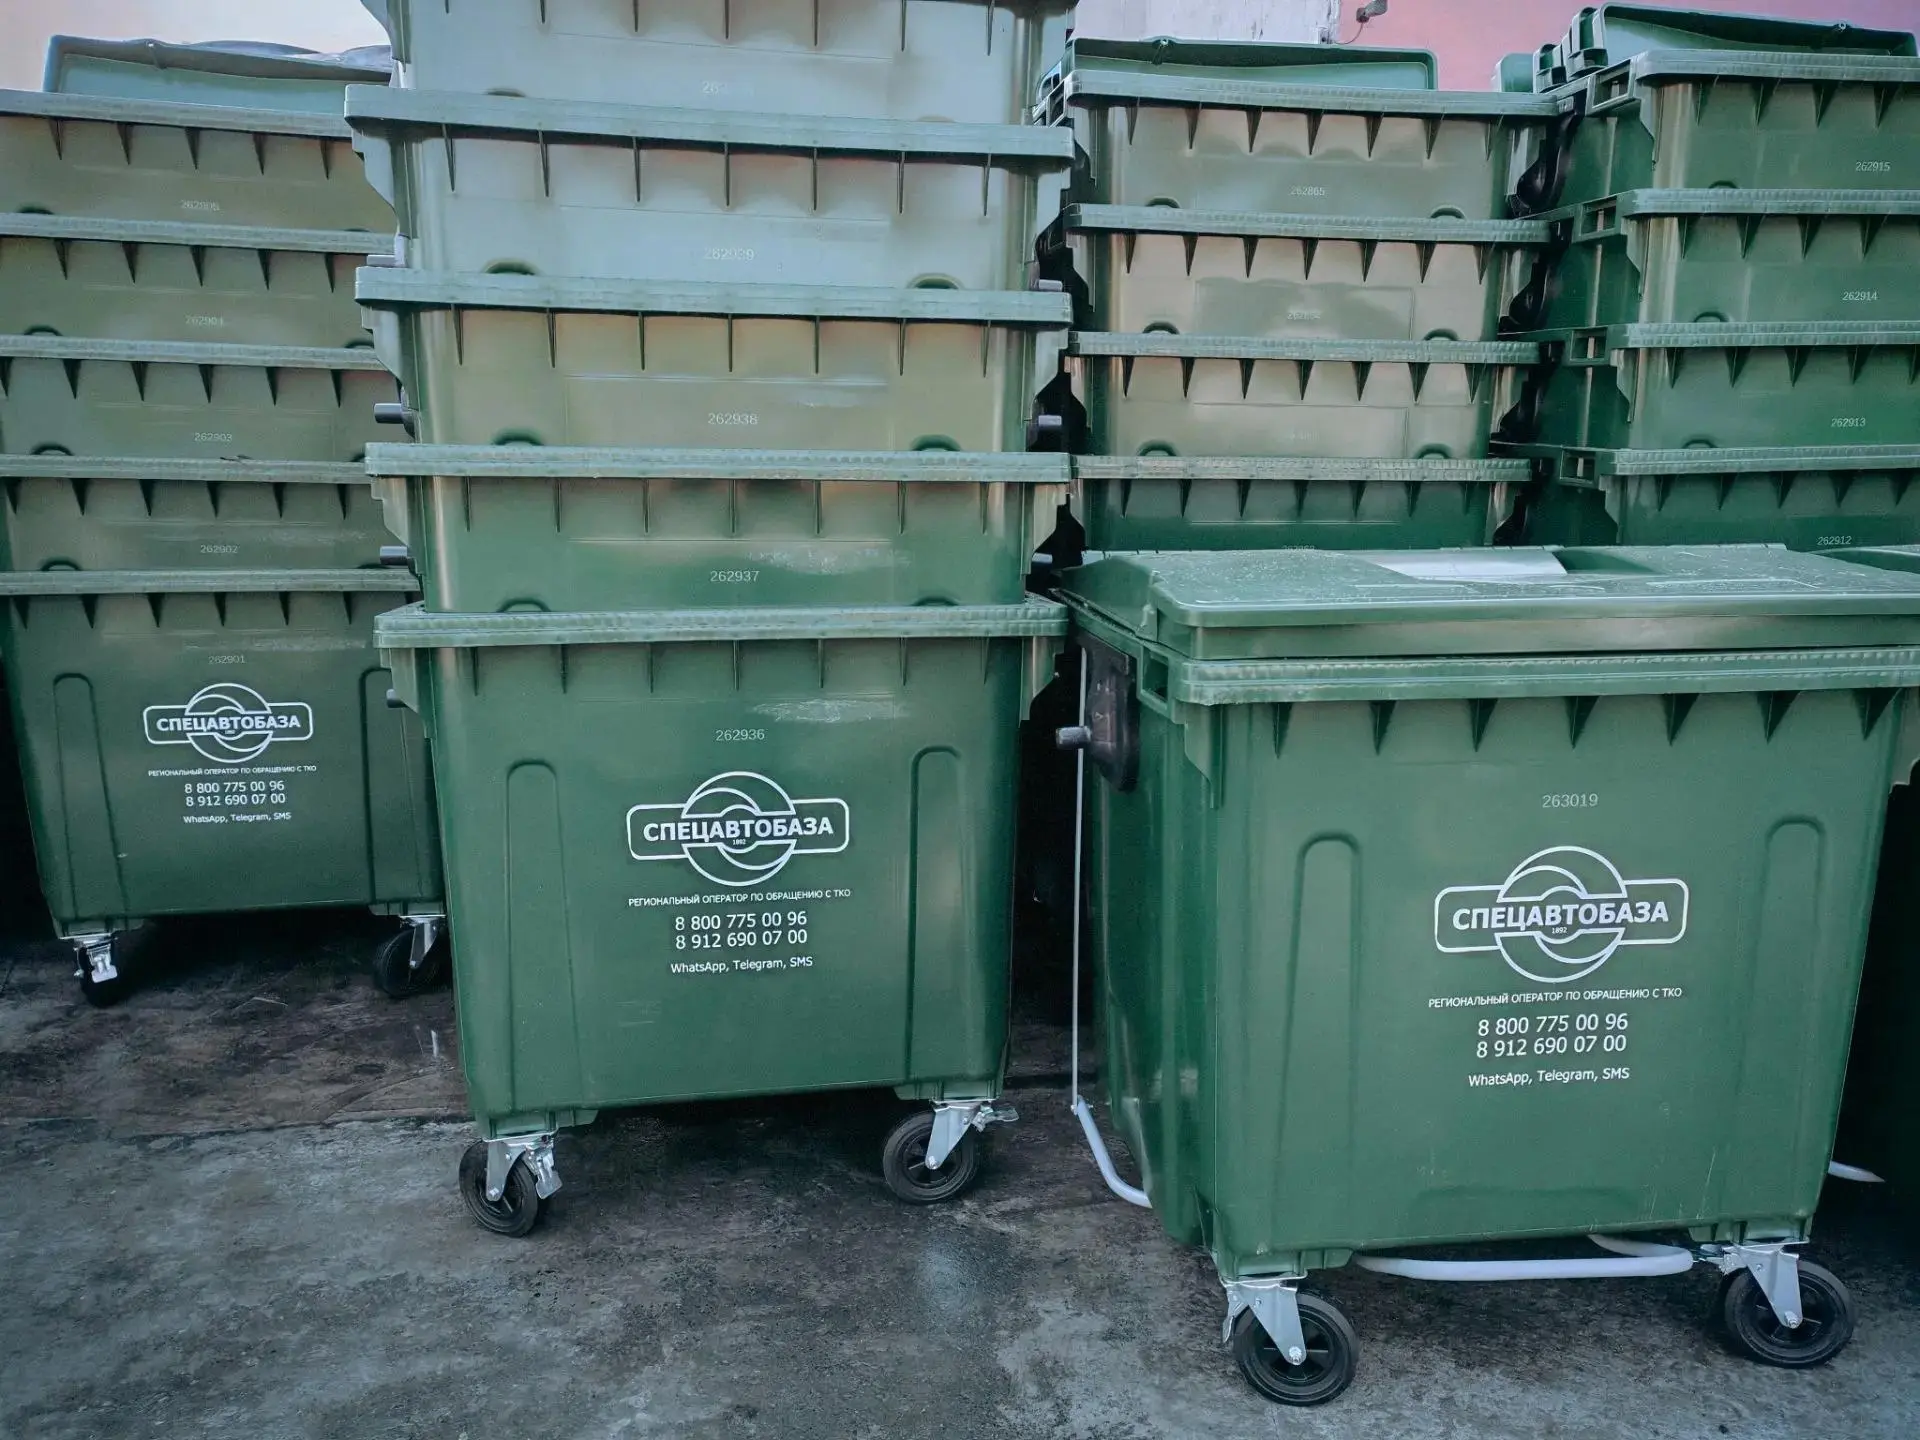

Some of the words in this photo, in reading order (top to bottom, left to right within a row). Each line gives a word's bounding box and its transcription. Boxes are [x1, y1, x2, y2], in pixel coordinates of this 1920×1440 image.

[1856, 162, 1890, 172] 262915
[1842, 291, 1878, 300] 262914
[1831, 417, 1866, 427] 262913
[1817, 536, 1852, 546] 262912
[710, 570, 760, 582] 262937
[156, 715, 300, 733] СПЕЦАВТОБАЗА
[715, 728, 765, 741] 262936
[185, 783, 192, 793] 8
[197, 783, 219, 793] 800
[223, 782, 246, 792] 775
[250, 781, 265, 791] 00
[269, 780, 284, 791] 96
[186, 796, 193, 806] 8
[198, 796, 221, 806] 912
[225, 794, 247, 805] 690
[251, 794, 266, 804] 07
[271, 793, 285, 804] 00
[1542, 793, 1599, 808] 263019
[183, 815, 228, 823] WhatsApp,
[230, 813, 271, 822] Telegram,
[274, 812, 291, 820] SMS
[643, 817, 833, 842] СПЕЦАВТОБАЗА
[628, 894, 700, 907] РЕГИОНАЛЬНЫЙ
[702, 893, 748, 904] ОПЕРАТОР
[750, 892, 764, 901] ПО
[765, 889, 823, 902] ОБРАЩЕНИЮ
[825, 889, 832, 897] С
[834, 888, 851, 897] ТКО
[675, 916, 685, 931] 8
[690, 914, 721, 930] 800
[727, 913, 756, 929] 775
[762, 912, 782, 927] 00
[787, 911, 807, 926] 96
[1452, 902, 1669, 930] СПЕЦАВТОБАЗА
[675, 935, 685, 950] 8
[691, 933, 721, 949] 912
[727, 932, 757, 947] 690
[763, 930, 782, 945] 07
[788, 929, 808, 944] 00
[670, 960, 729, 973] WhatsApp,
[733, 958, 787, 971] Telegram,
[789, 957, 813, 967] SMS
[1428, 992, 1509, 1008] РЕГИОНАЛЬНЫЙ
[1511, 991, 1563, 1003] ОПЕРАТОР
[1566, 990, 1580, 1000] ПО
[1583, 988, 1650, 1002] ОБРАЩЕНИЮ
[1652, 988, 1660, 997] С
[1662, 987, 1682, 997] ТКО
[1478, 1019, 1490, 1036] 8
[1496, 1017, 1529, 1034] 800
[1536, 1016, 1570, 1032] 775
[1576, 1014, 1598, 1031] 00
[1605, 1012, 1628, 1030] 96
[1476, 1041, 1488, 1058] 8
[1494, 1039, 1527, 1057] 912
[1534, 1037, 1568, 1054] 690
[1574, 1036, 1597, 1052] 07
[1603, 1034, 1626, 1052] 00
[1468, 1072, 1532, 1088] WhatsApp,
[1537, 1070, 1598, 1084] Telegram,
[1602, 1068, 1630, 1080] SMS
